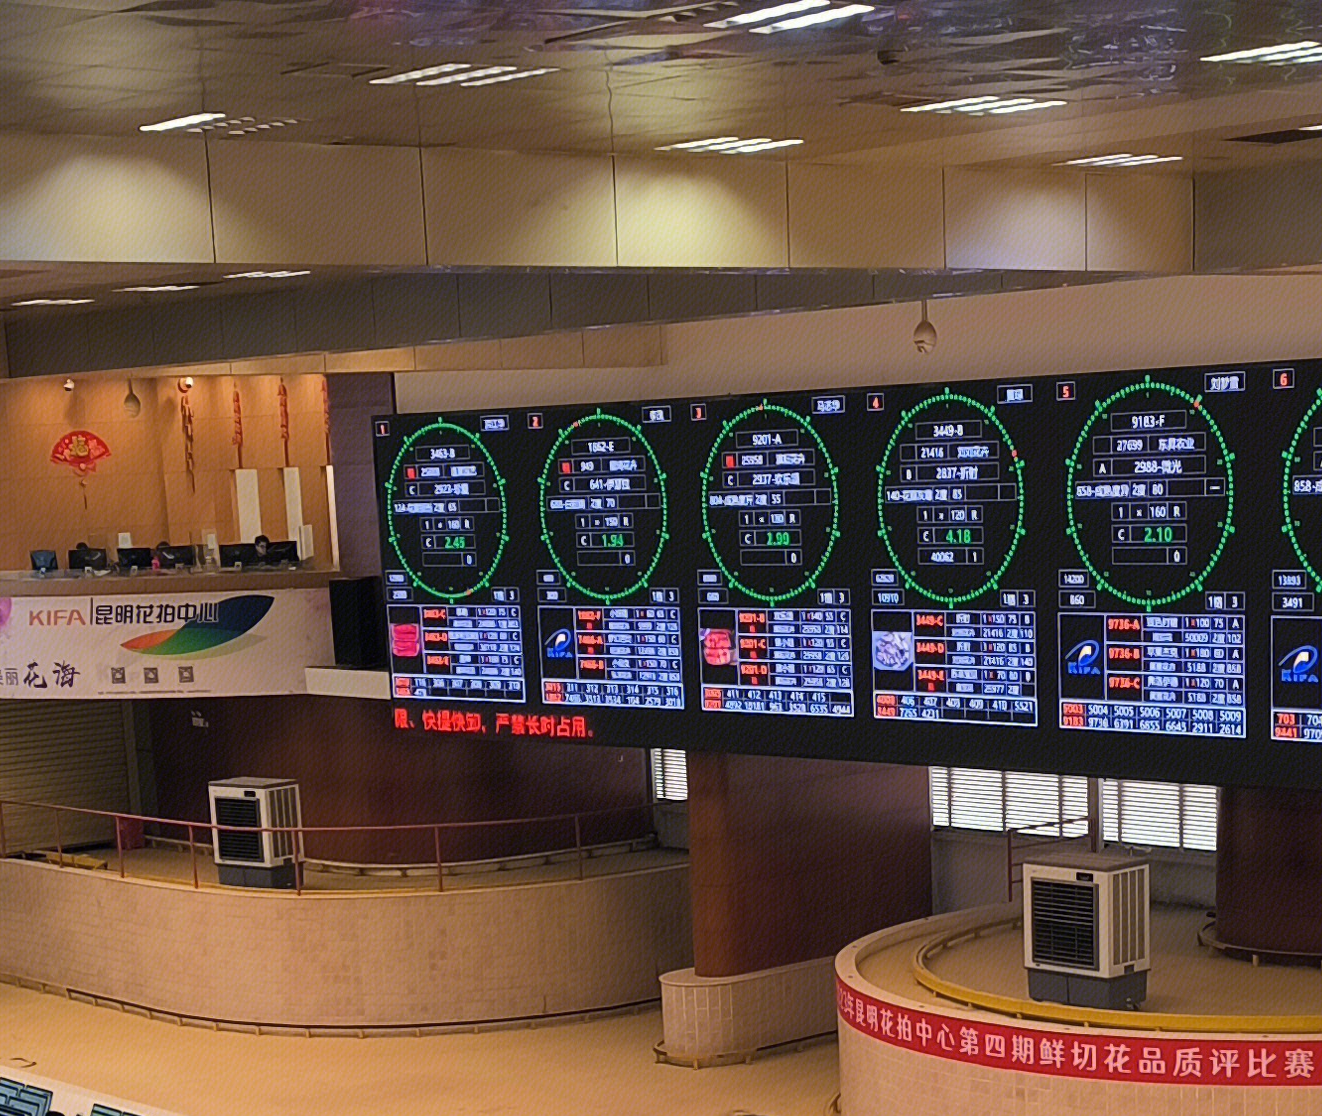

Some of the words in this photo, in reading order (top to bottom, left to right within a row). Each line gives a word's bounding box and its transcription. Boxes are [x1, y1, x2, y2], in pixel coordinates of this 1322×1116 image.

[1280, 374, 1288, 386] 6
[1144, 527, 1173, 542] 2.10
[28, 610, 86, 626] KIFA
[95, 602, 219, 626] 昆明花拍中心
